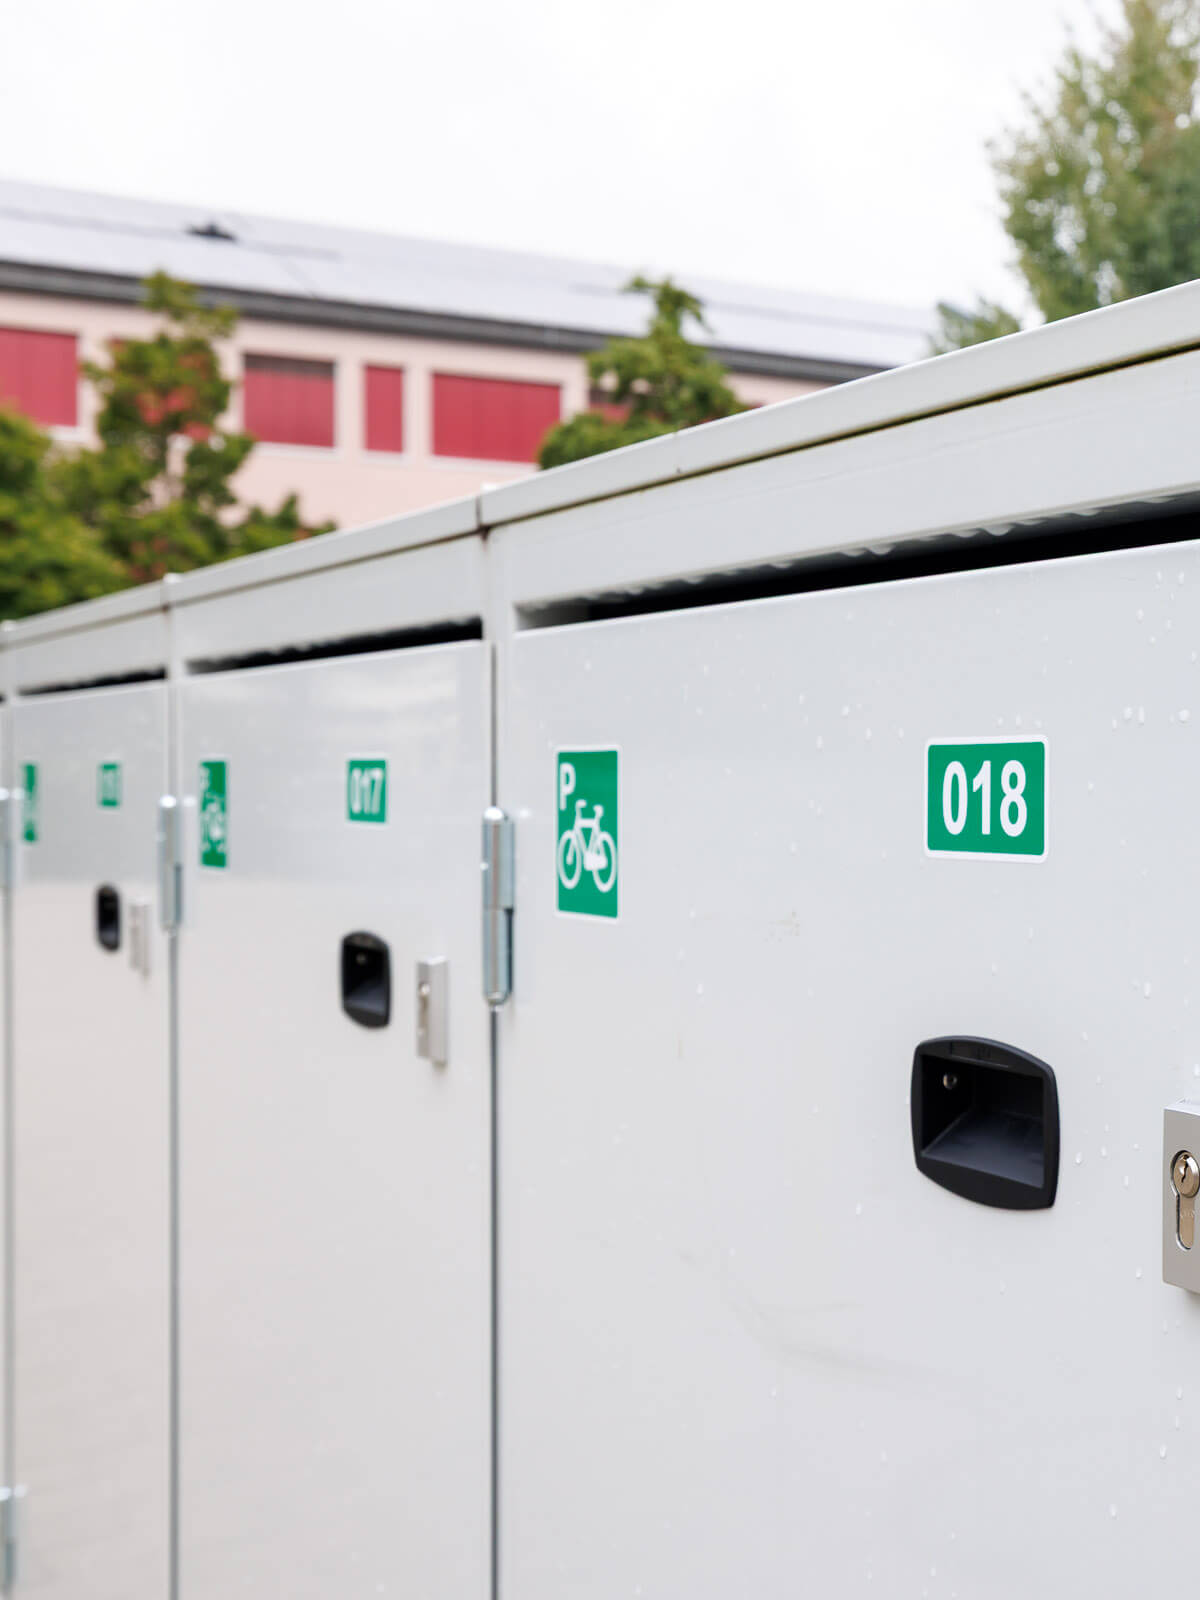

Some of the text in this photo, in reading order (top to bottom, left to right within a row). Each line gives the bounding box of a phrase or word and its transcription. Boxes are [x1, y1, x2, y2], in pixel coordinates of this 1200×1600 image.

[350, 768, 384, 814] 017
[559, 762, 576, 810] P
[942, 759, 1028, 837] 018
